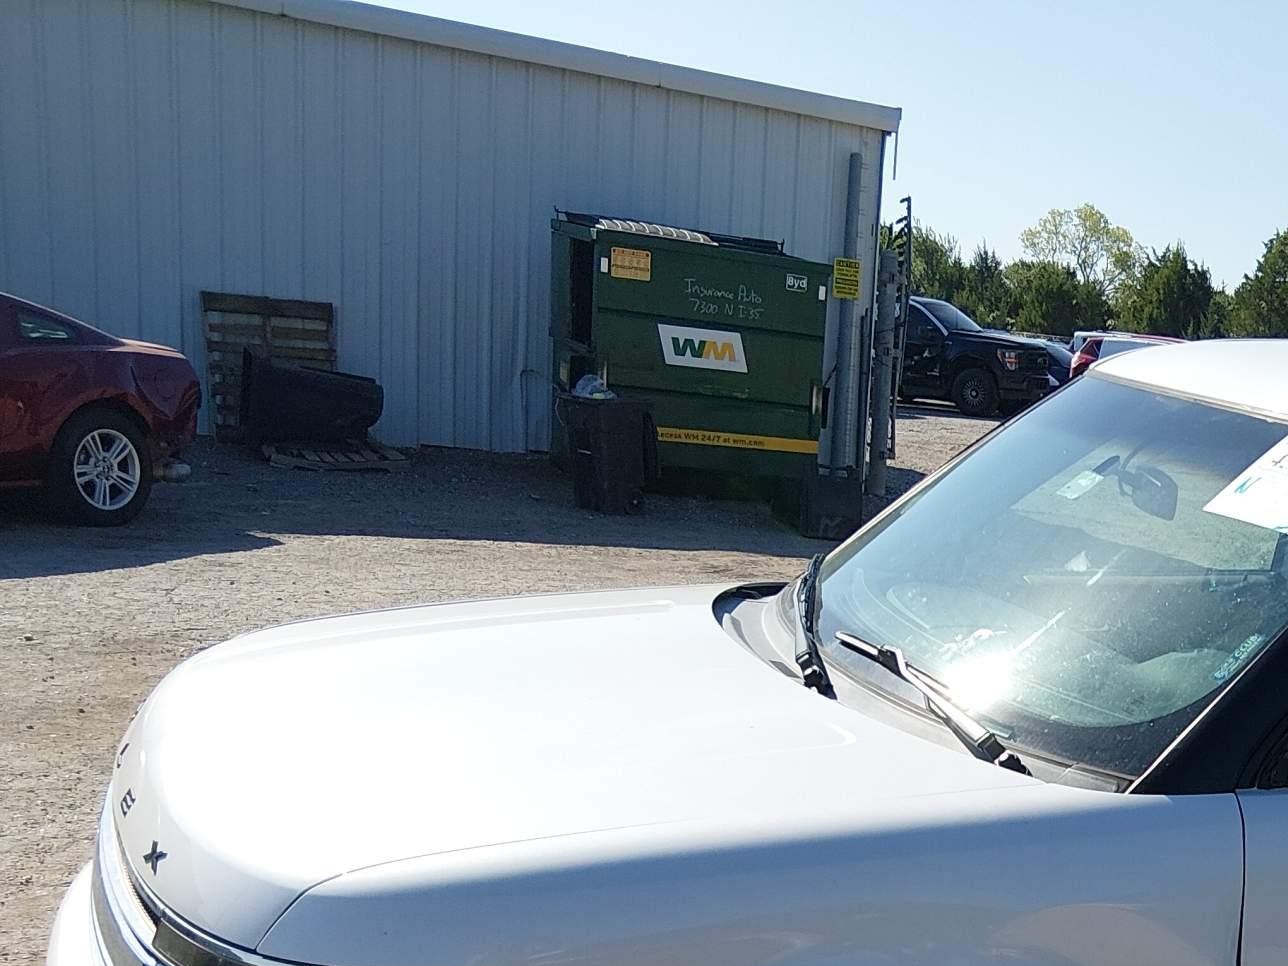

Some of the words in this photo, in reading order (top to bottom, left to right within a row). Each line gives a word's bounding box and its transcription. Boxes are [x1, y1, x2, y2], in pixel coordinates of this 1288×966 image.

[683, 279, 735, 300] Insurance
[738, 285, 762, 303] Auto
[724, 304, 734, 316] N
[672, 336, 736, 363] WM
